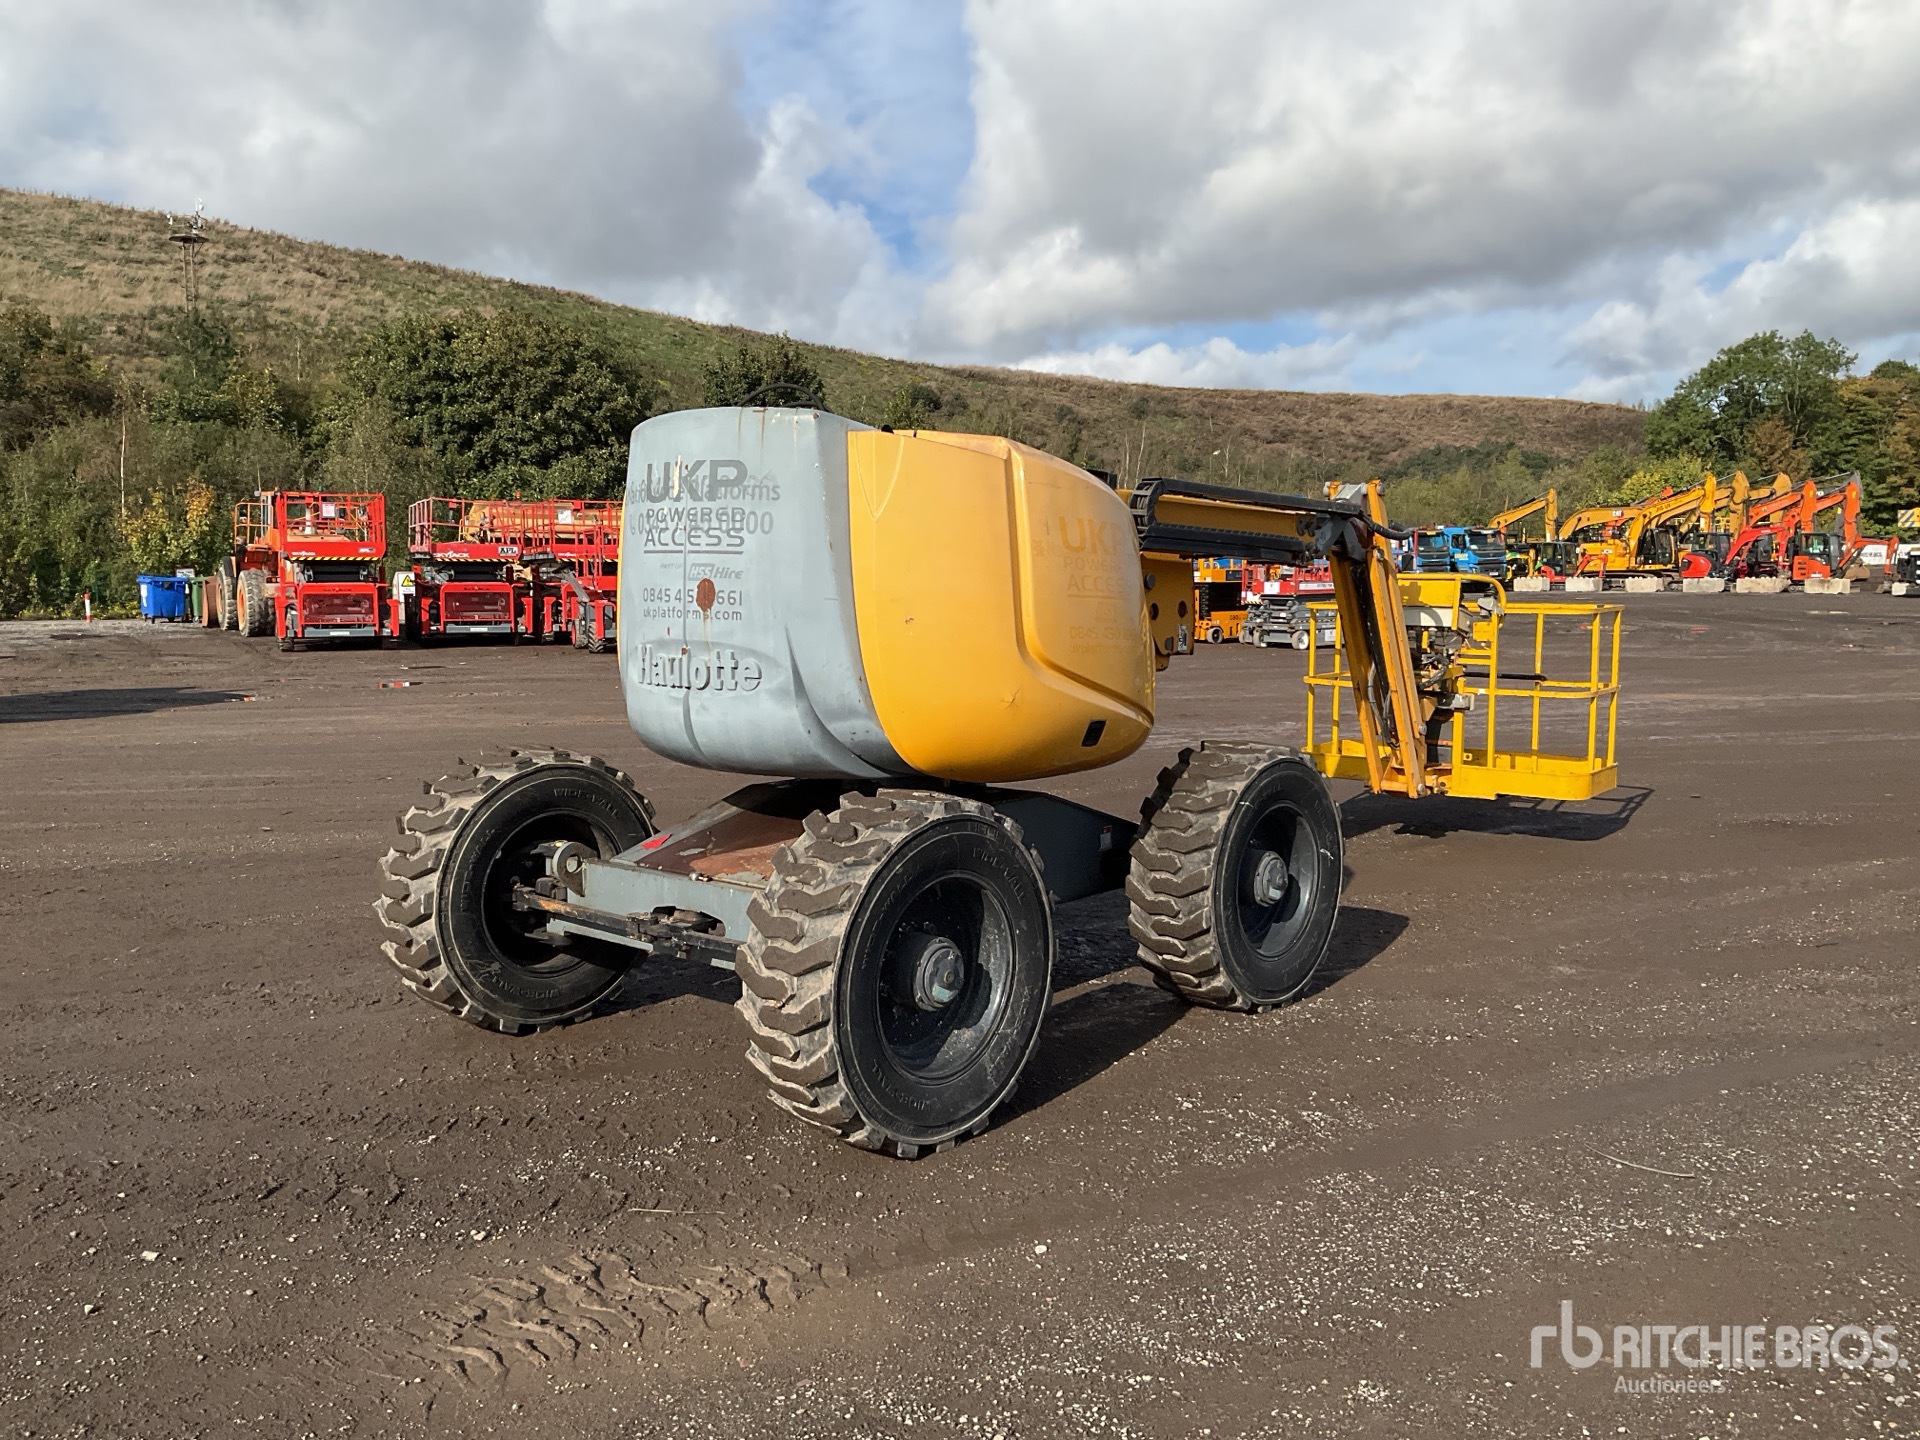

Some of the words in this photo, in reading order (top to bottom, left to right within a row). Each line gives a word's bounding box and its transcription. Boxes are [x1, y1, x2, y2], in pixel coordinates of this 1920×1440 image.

[646, 459, 748, 503] UKP
[646, 507, 746, 523] POWERED
[644, 526, 745, 547] ACCESS
[689, 566, 712, 580] HSS
[714, 567, 744, 579] Hire
[643, 588, 671, 603] 0845
[643, 607, 743, 621] ukplatforms.com
[637, 644, 762, 691] Haulotte
